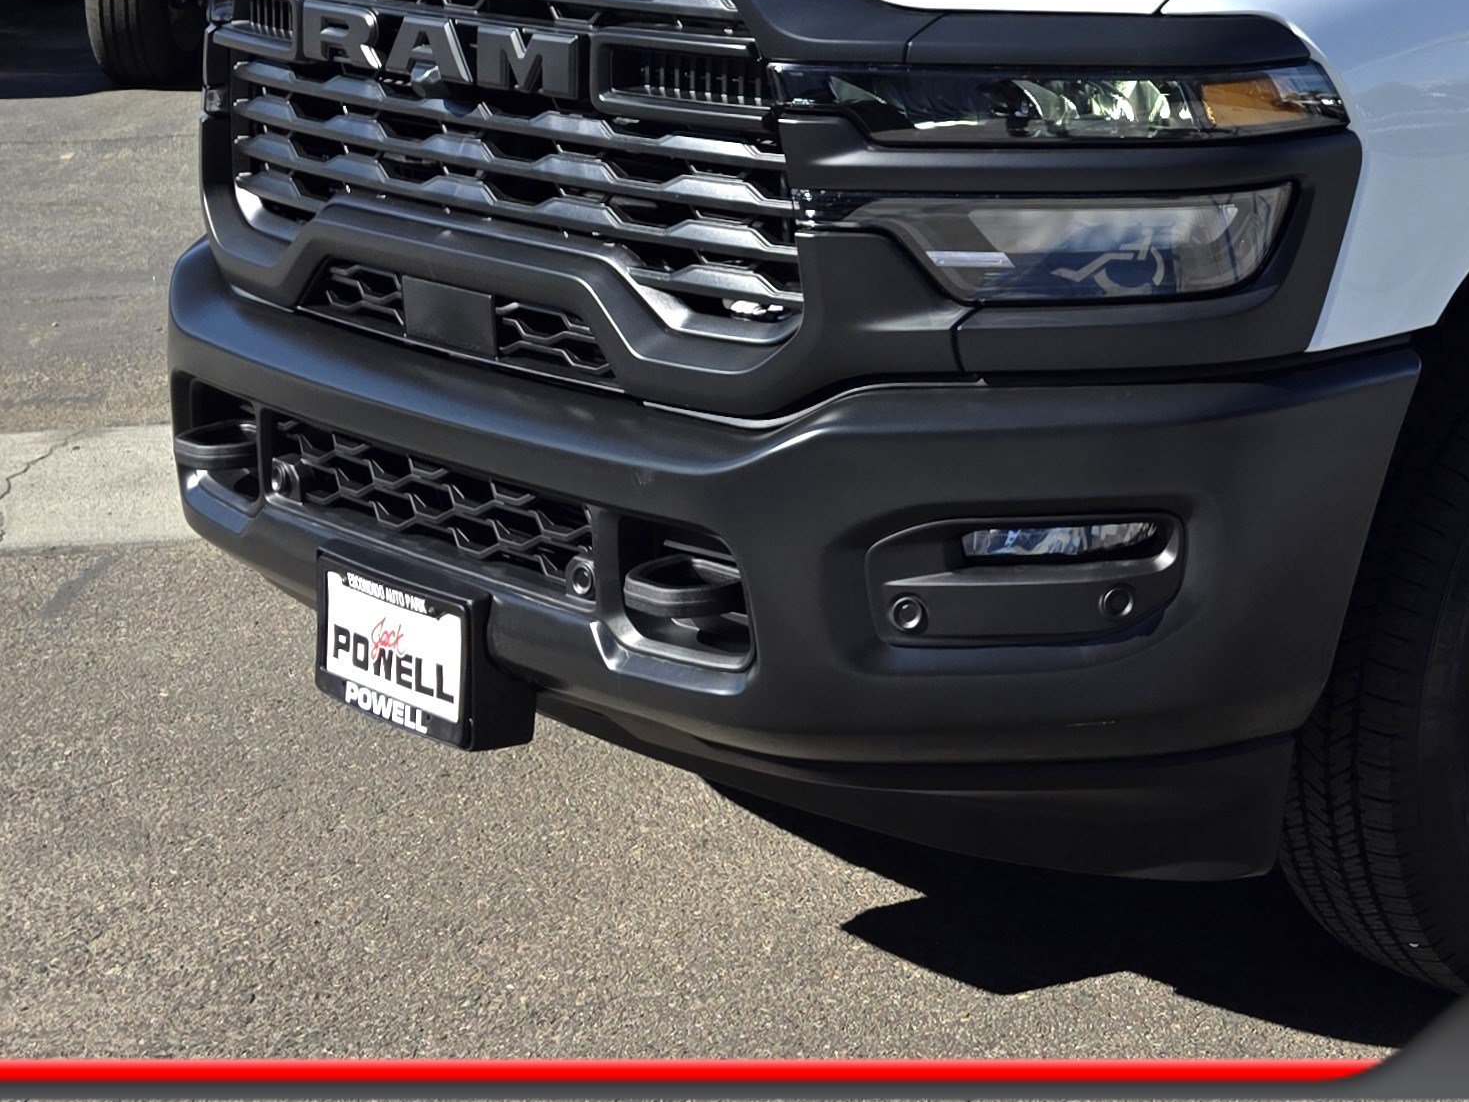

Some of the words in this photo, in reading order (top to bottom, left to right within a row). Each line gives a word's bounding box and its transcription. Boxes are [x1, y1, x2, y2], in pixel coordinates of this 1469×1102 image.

[385, 586, 406, 608] AUTO
[332, 622, 455, 704] POWELL
[370, 616, 406, 661] Jack
[344, 679, 429, 735] POWELL
